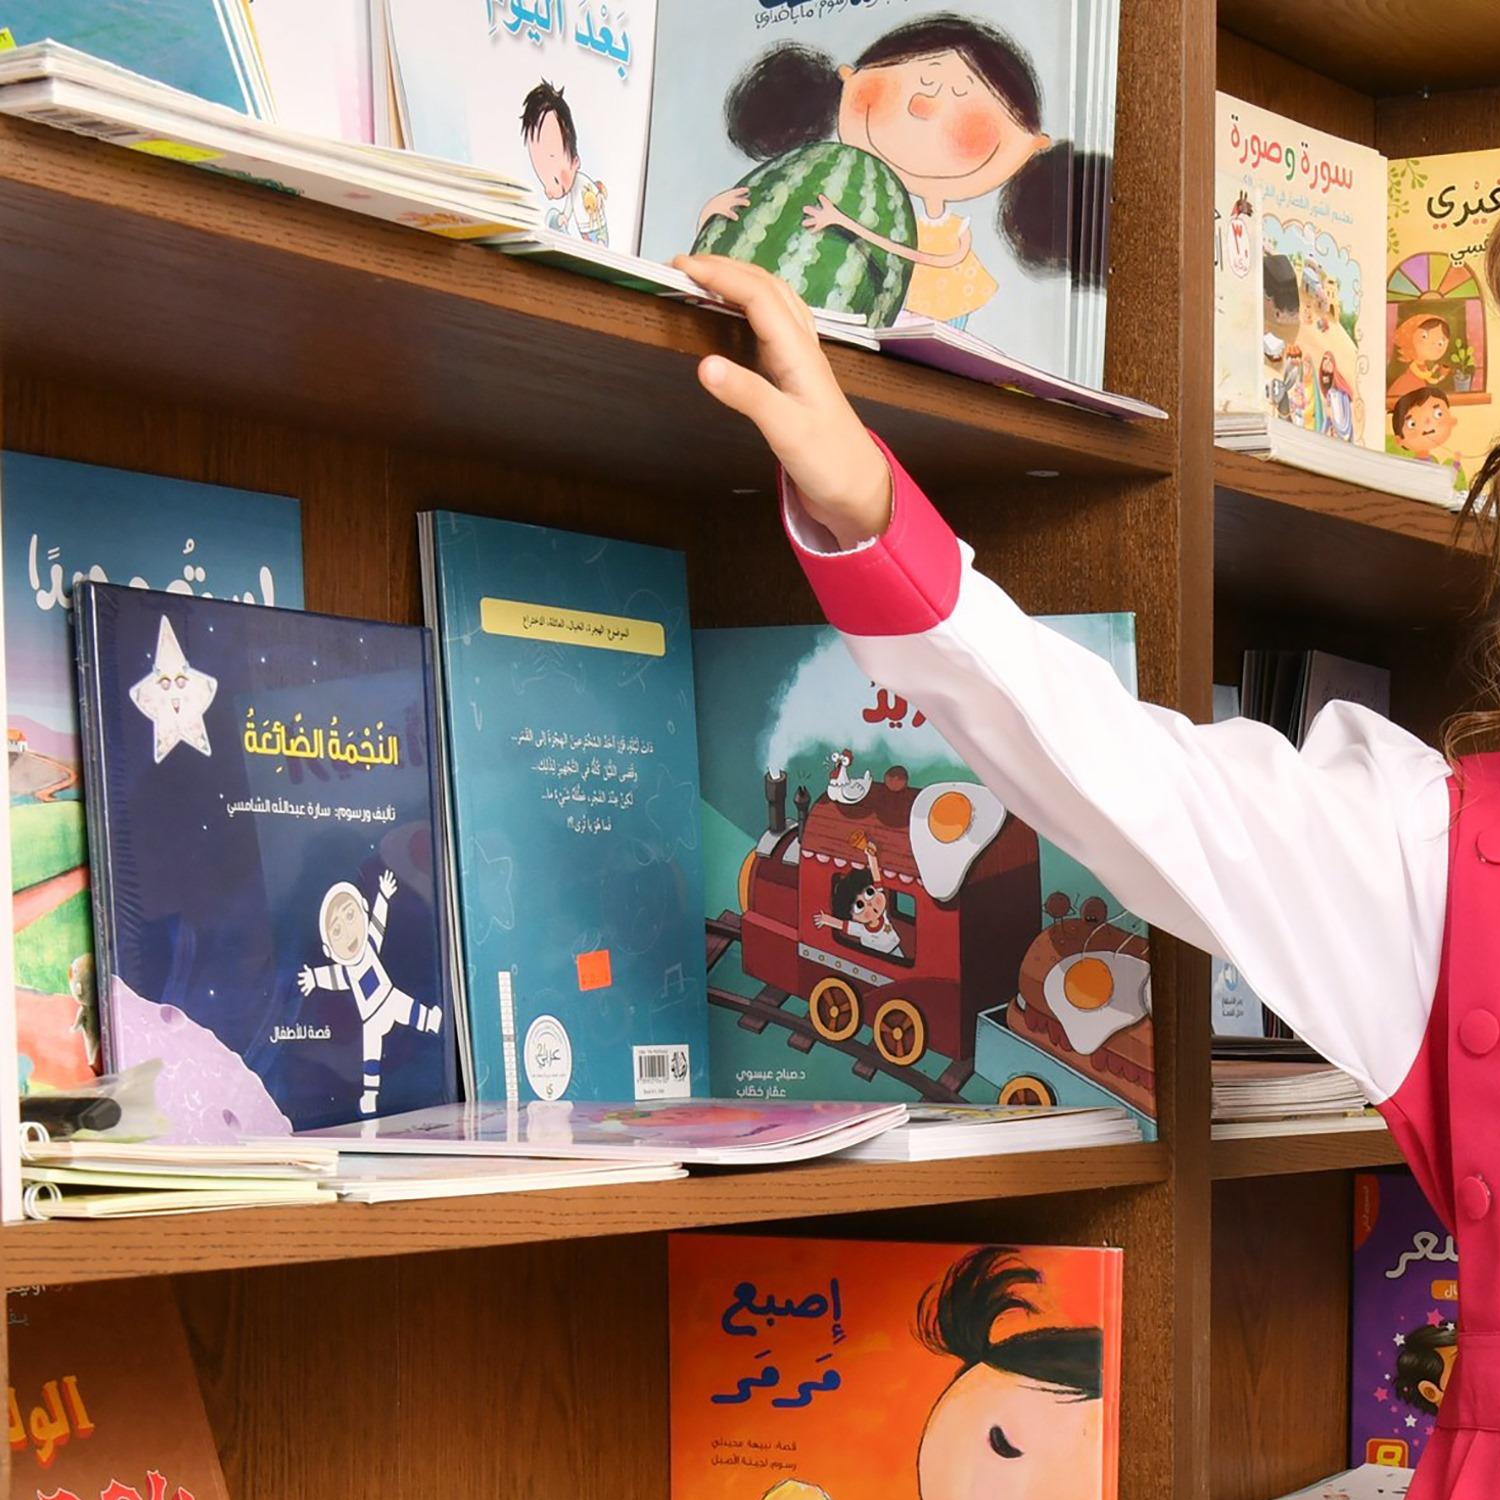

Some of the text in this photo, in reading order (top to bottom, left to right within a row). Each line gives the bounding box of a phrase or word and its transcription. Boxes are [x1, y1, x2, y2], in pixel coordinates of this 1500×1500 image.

[1301, 141, 1353, 193] سورة
[226, 796, 397, 824] تأليف ورسوم: سارة عبدالله الشامسي
[269, 1022, 332, 1044] قصة للأطفال
[735, 1069, 774, 1082] عيسوي
